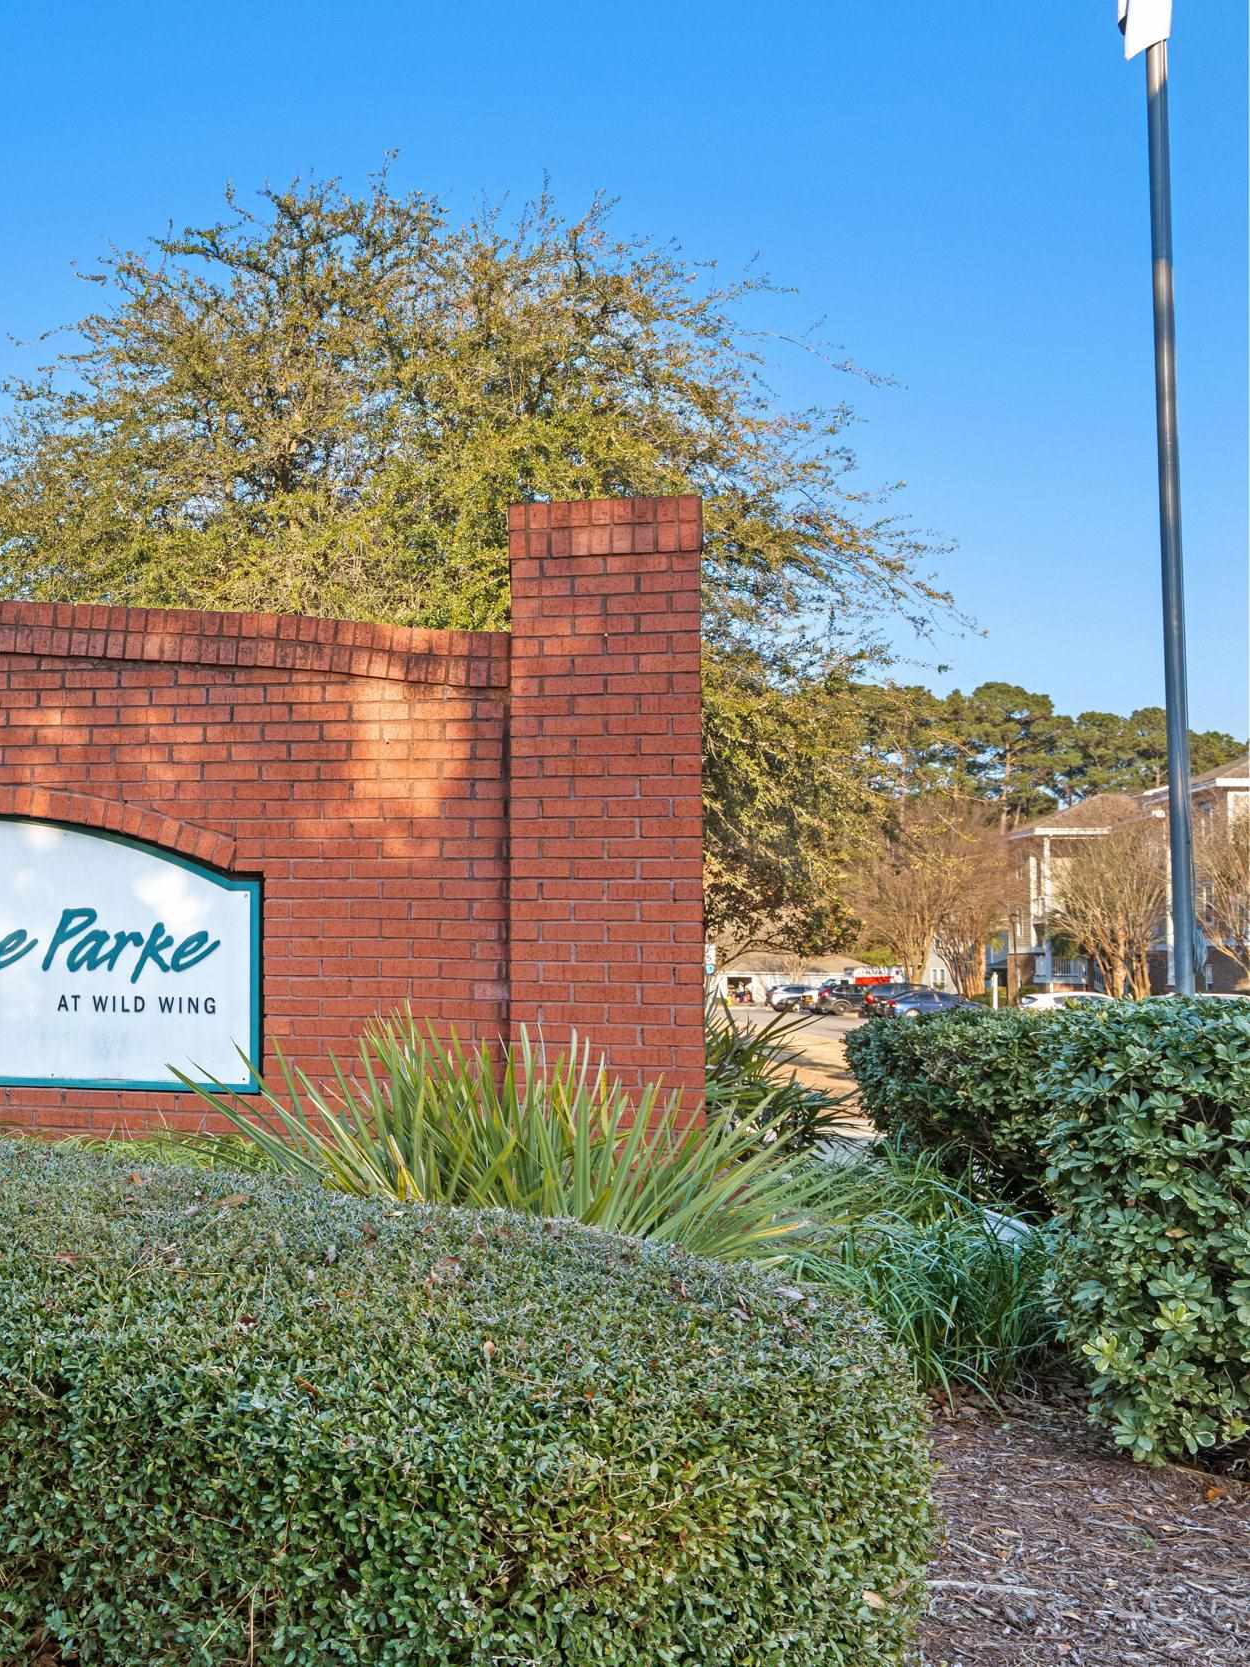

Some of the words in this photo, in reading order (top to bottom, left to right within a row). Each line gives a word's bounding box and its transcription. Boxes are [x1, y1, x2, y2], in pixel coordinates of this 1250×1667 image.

[42, 907, 221, 983] Parke
[57, 994, 81, 1012] AT
[92, 995, 146, 1014] WILD
[158, 996, 217, 1015] WING
